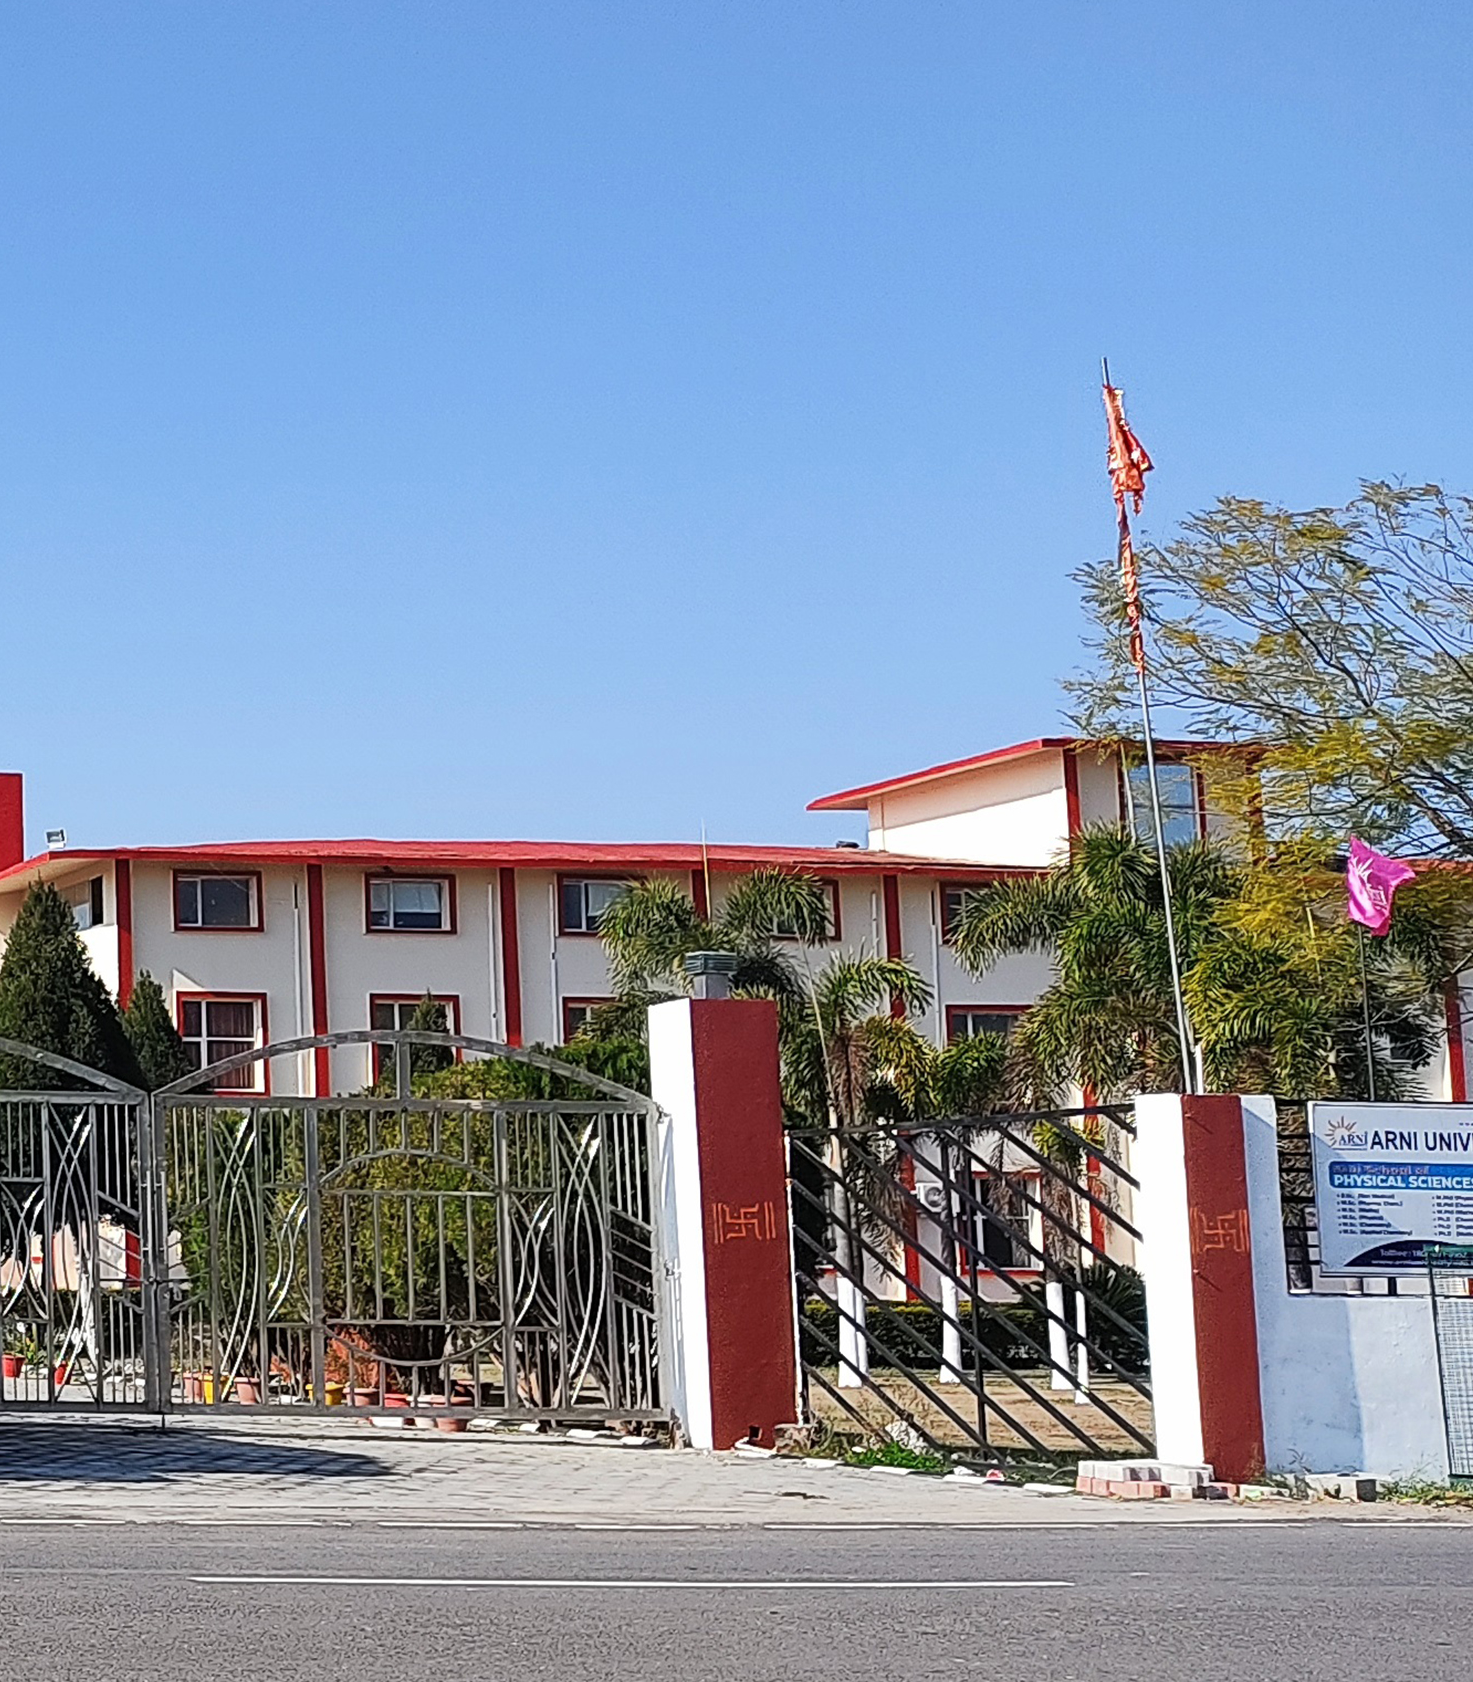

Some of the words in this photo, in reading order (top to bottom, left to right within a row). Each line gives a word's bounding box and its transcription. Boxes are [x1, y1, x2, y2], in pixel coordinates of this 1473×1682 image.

[1338, 1131, 1368, 1146] ARNI
[1369, 1130, 1419, 1151] ARNI
[1424, 1131, 1473, 1152] UNIV
[1333, 1174, 1407, 1188] PHYSICAL
[1408, 1175, 1473, 1189] SCIENCE
